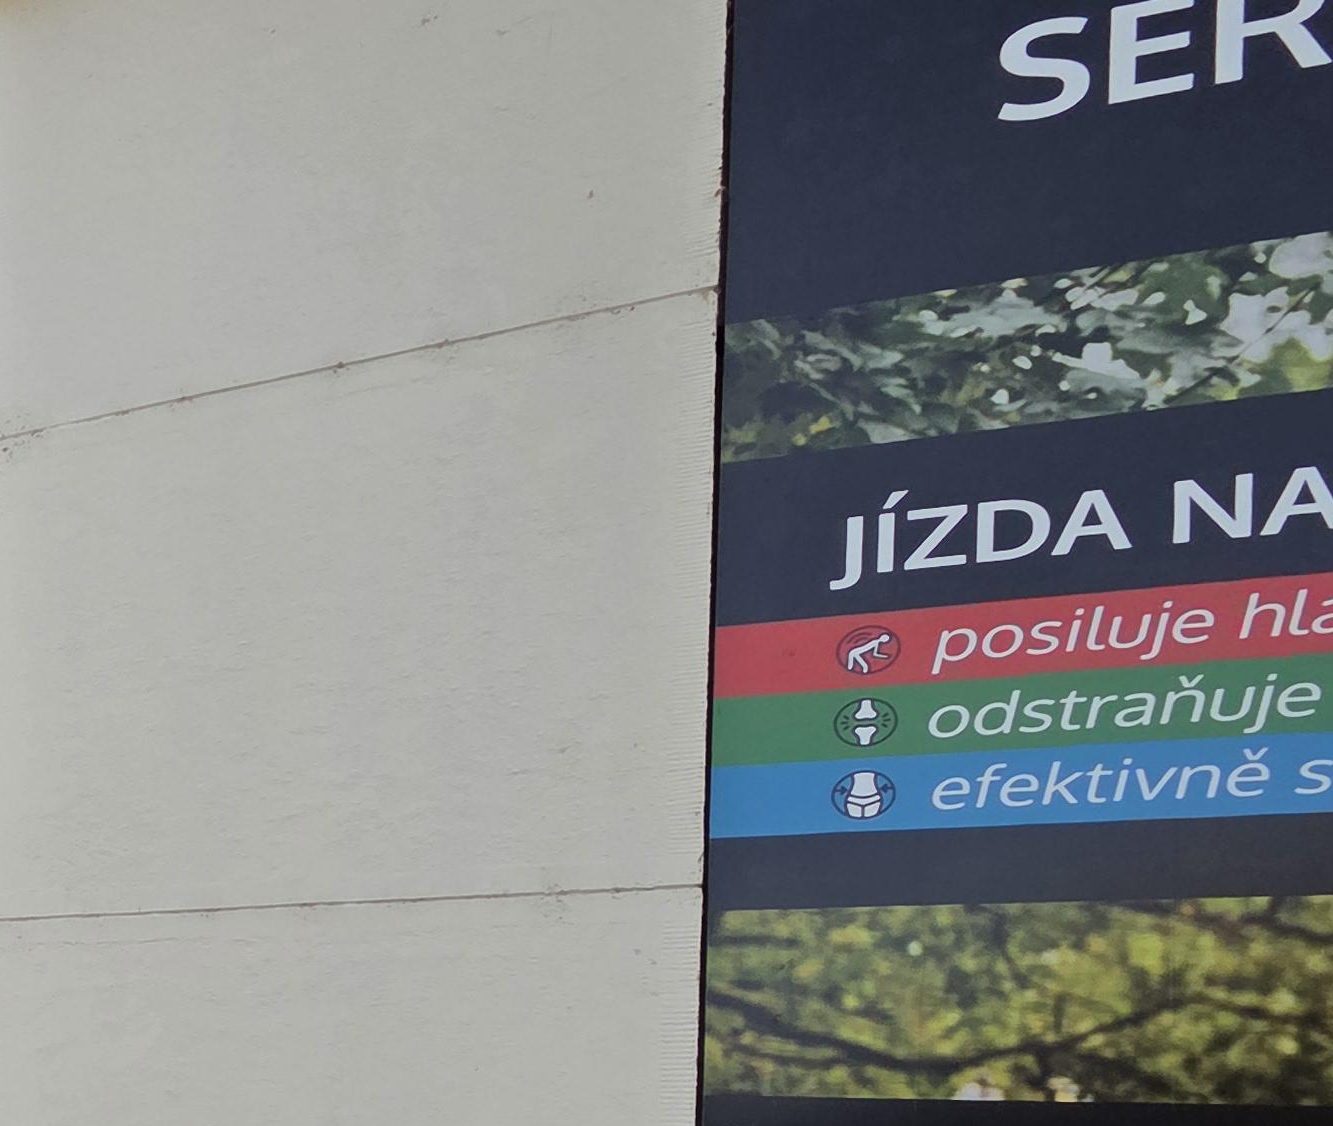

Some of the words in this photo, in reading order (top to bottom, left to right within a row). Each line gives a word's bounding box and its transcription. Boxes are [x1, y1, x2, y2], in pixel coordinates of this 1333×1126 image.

[997, 0, 1333, 122] SER
[829, 489, 1133, 591] JÍZDA
[1173, 466, 1333, 544] NA
[931, 600, 1215, 675] posiluje
[928, 673, 1322, 738] odstraňuje
[931, 747, 1270, 810] efektivně
